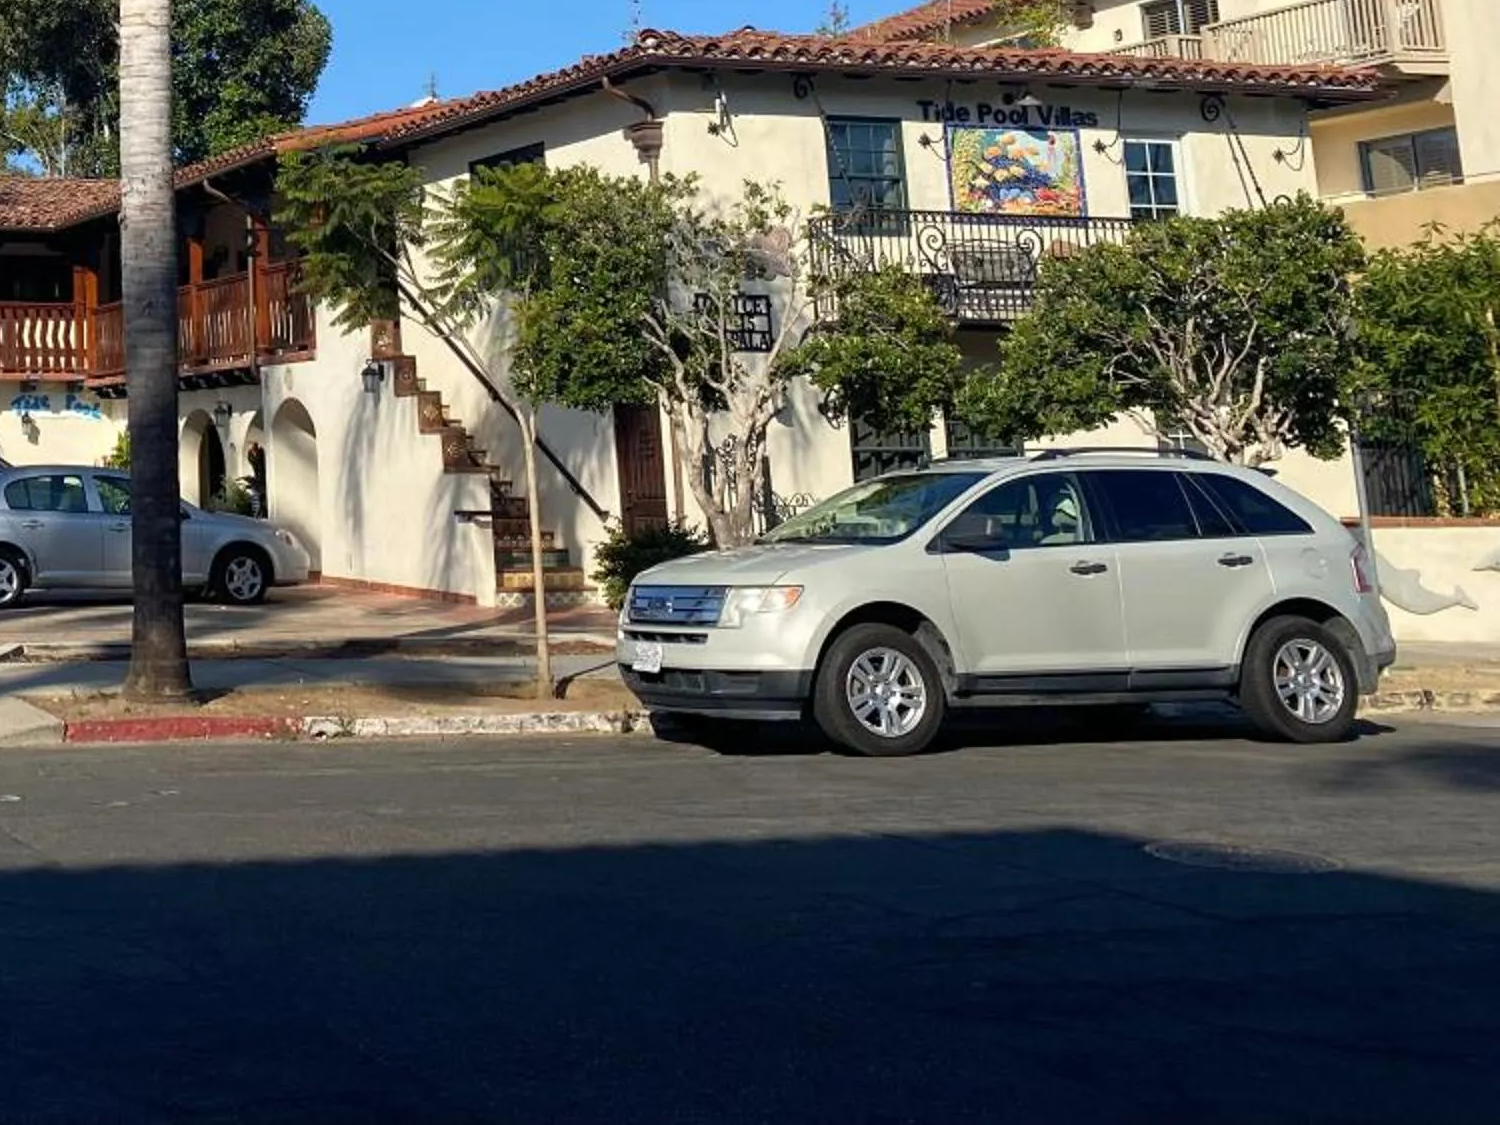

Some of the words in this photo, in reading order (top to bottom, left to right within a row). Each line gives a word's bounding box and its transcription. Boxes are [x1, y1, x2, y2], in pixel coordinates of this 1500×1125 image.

[916, 100, 970, 122] Tide
[977, 103, 1029, 124] Pool
[1036, 105, 1099, 125] Villas
